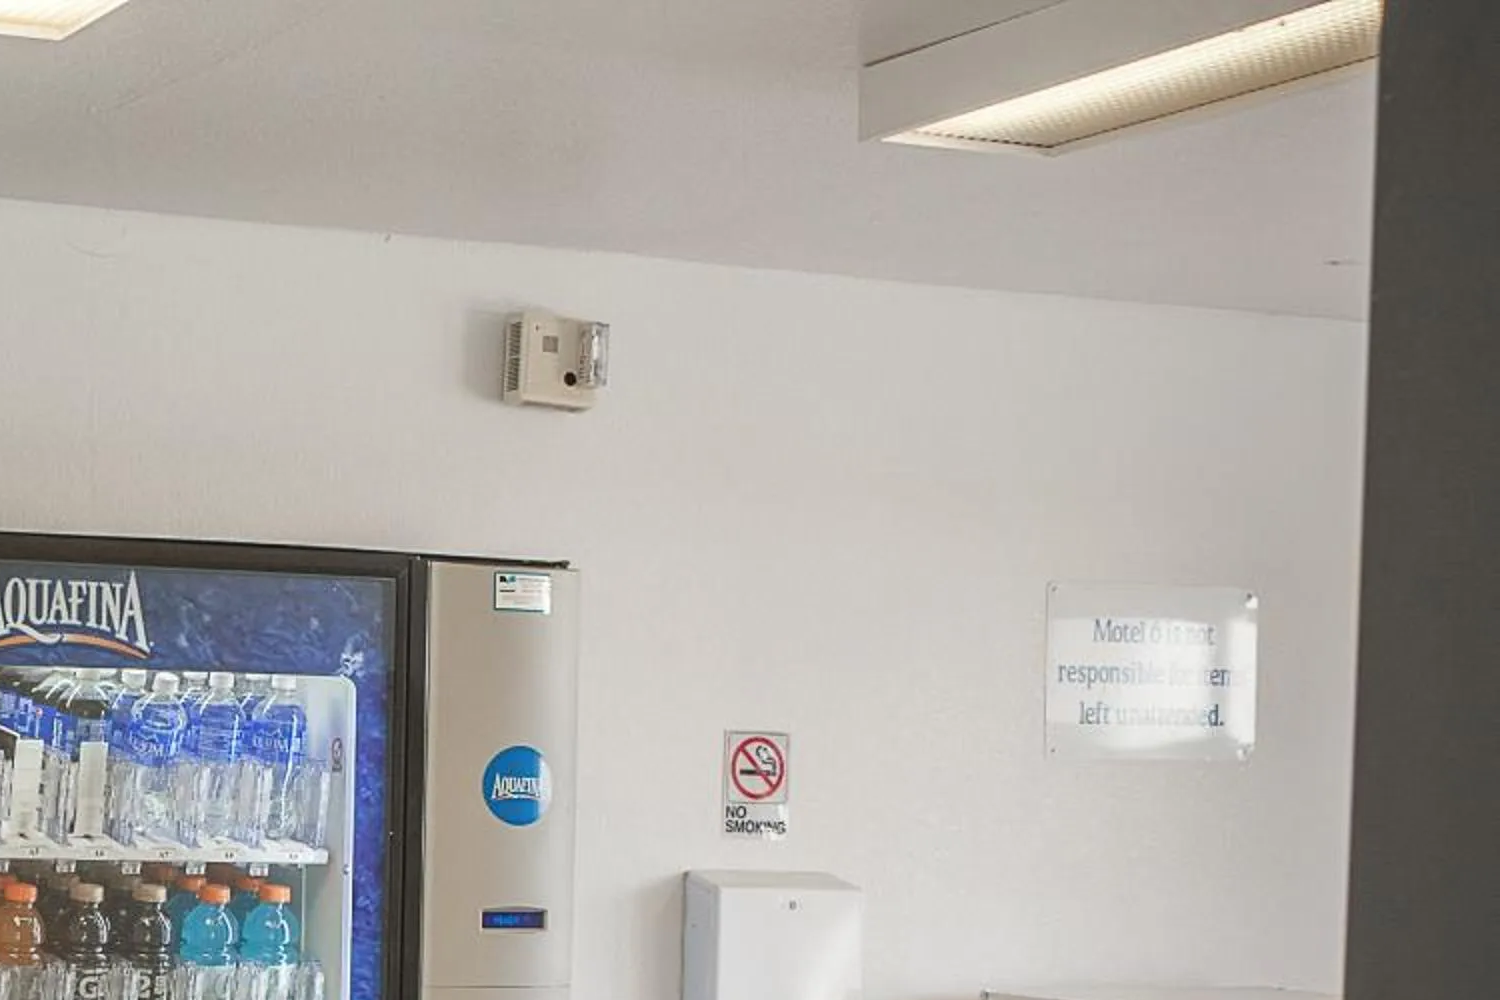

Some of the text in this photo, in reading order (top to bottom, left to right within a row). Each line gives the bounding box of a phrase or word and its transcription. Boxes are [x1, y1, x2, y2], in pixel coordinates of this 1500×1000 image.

[1093, 619, 1146, 644] Motel
[1078, 700, 1110, 725] left
[492, 773, 546, 799] AQUAFIN
[725, 806, 747, 818] NO
